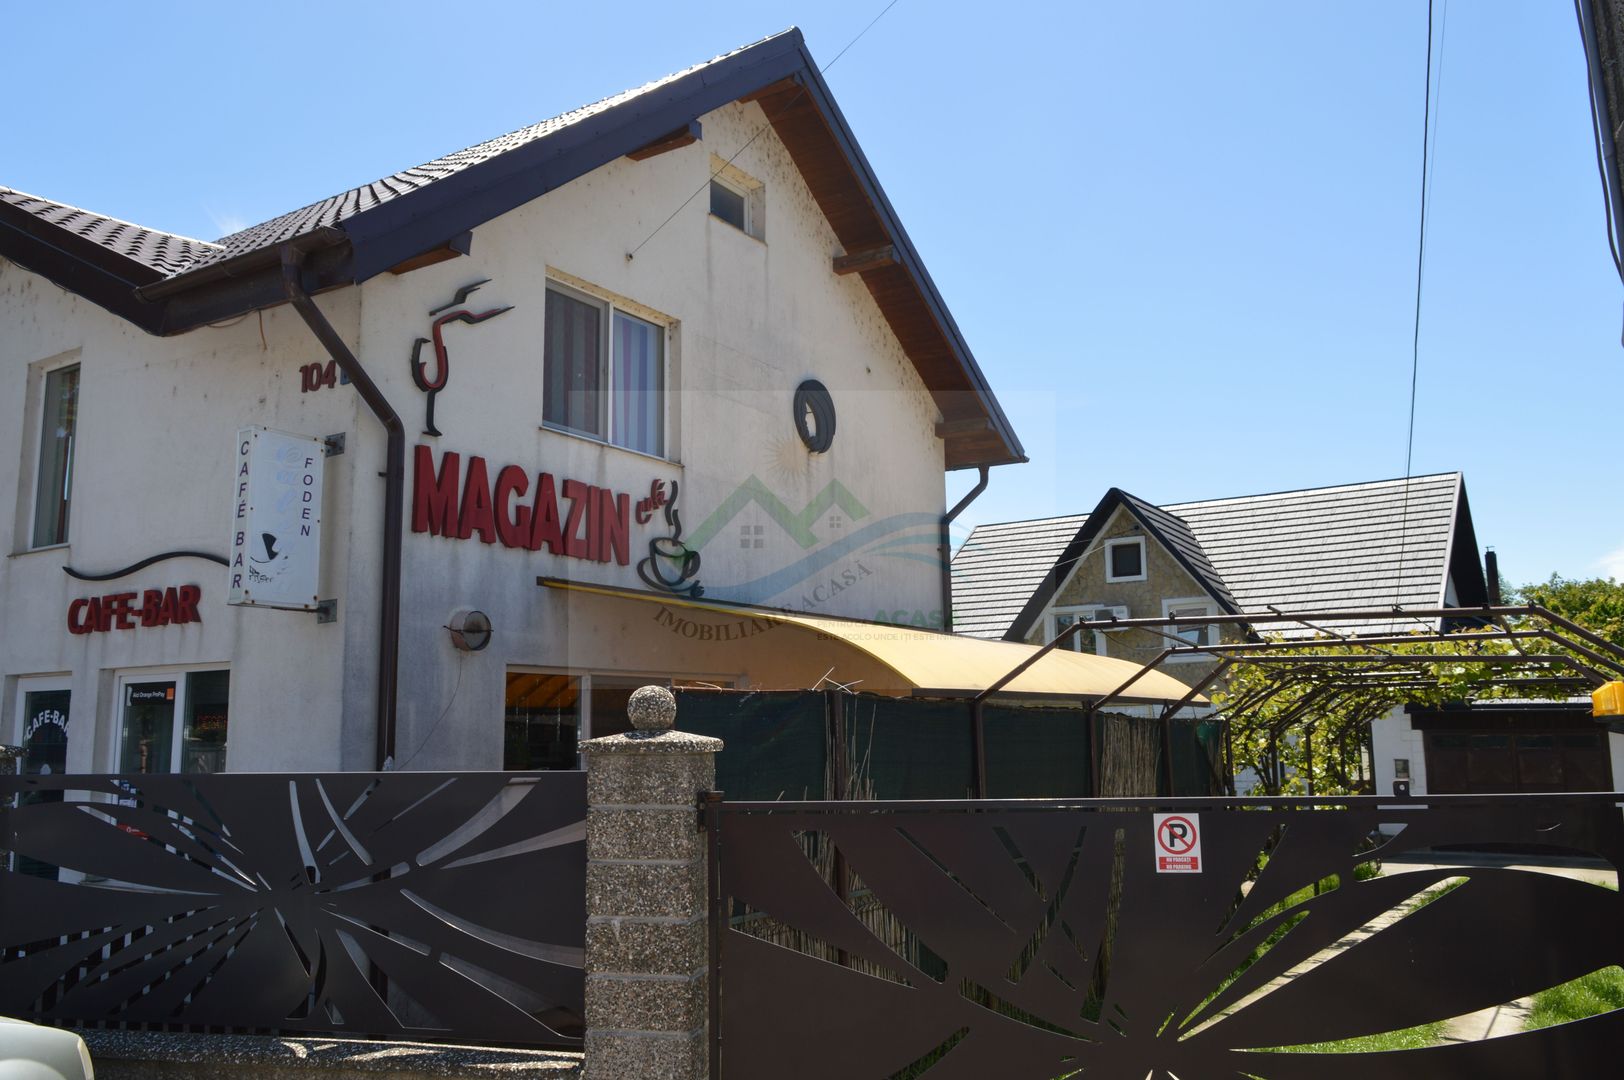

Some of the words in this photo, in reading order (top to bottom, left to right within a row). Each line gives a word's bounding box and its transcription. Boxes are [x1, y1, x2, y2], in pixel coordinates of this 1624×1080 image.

[299, 360, 337, 393] 104
[300, 457, 314, 537] FODEN
[411, 445, 630, 566] MAGAZIN
[232, 531, 246, 589] BAR
[67, 584, 202, 635] CAFE-BAR
